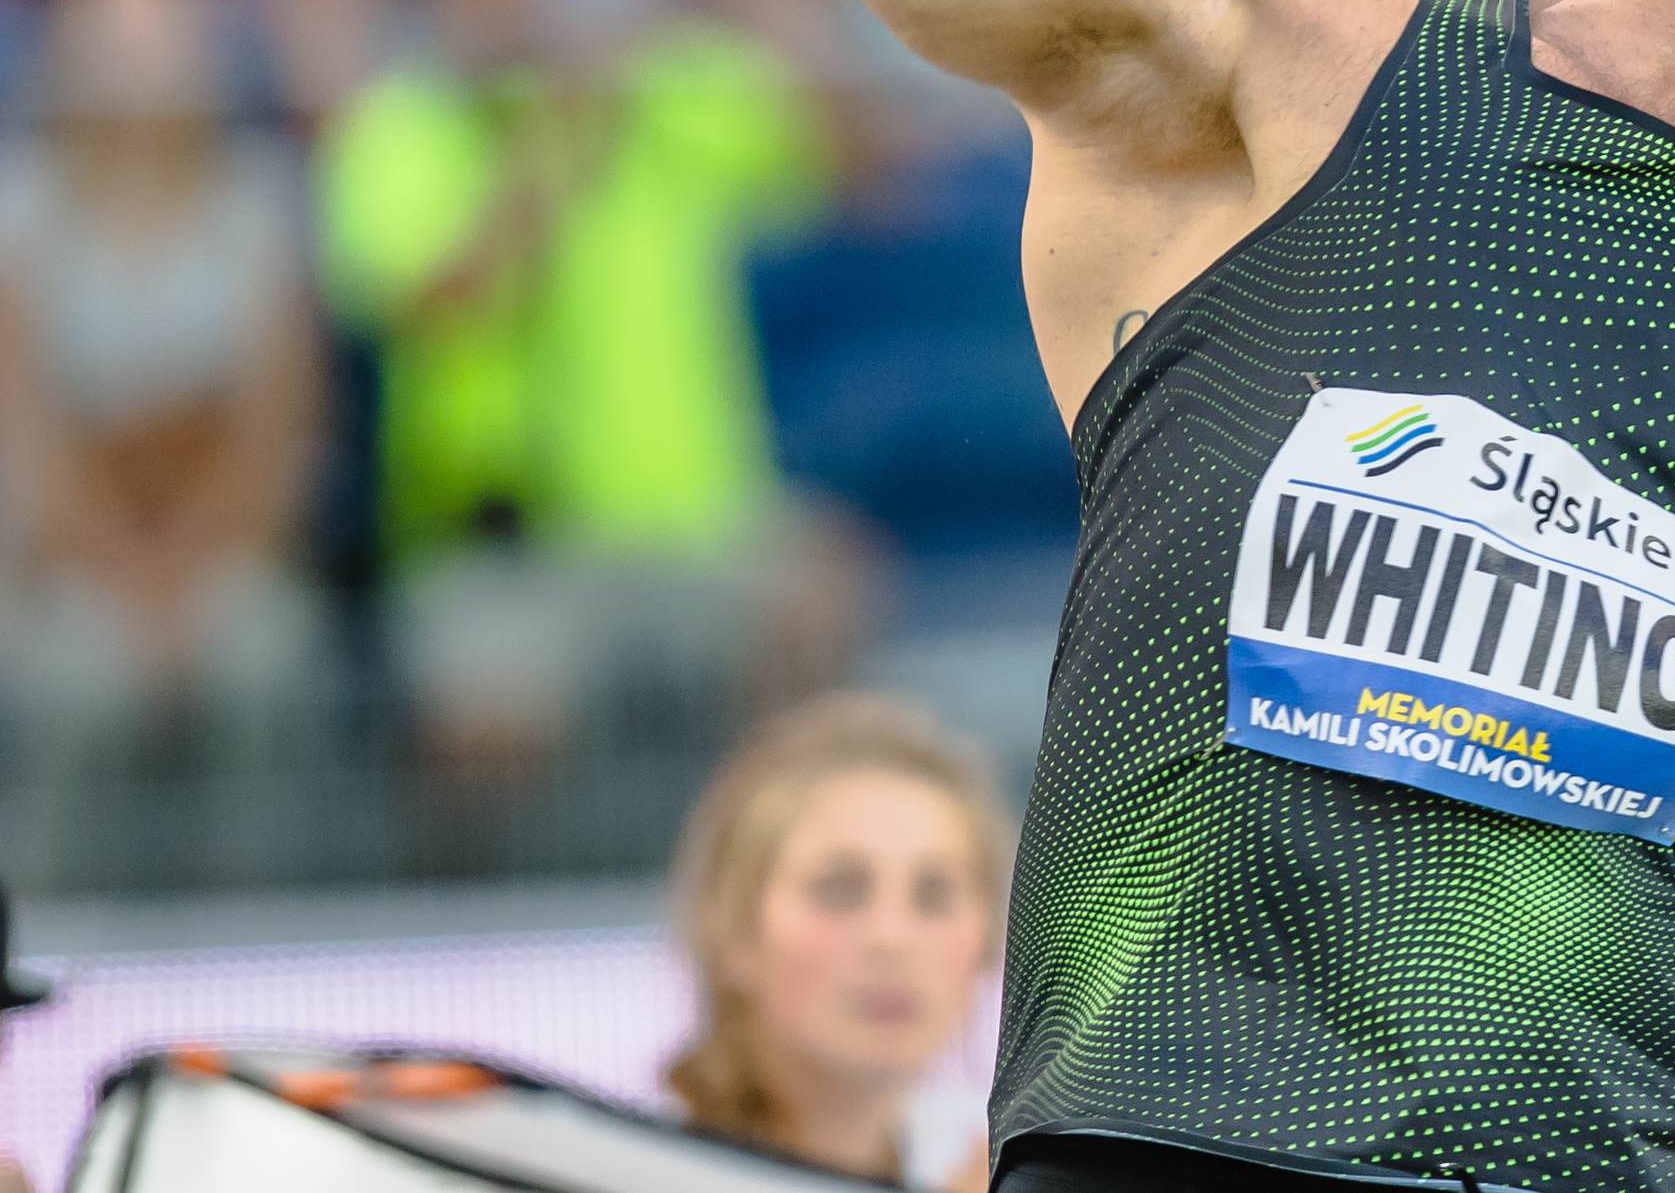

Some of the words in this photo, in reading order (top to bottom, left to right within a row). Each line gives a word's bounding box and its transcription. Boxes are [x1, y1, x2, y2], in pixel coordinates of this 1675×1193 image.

[1250, 697, 1357, 747] KAMILI
[1364, 722, 1663, 819] SKOLIMOWSKIEJ
[1357, 688, 1552, 763] MEMORIAŁ
